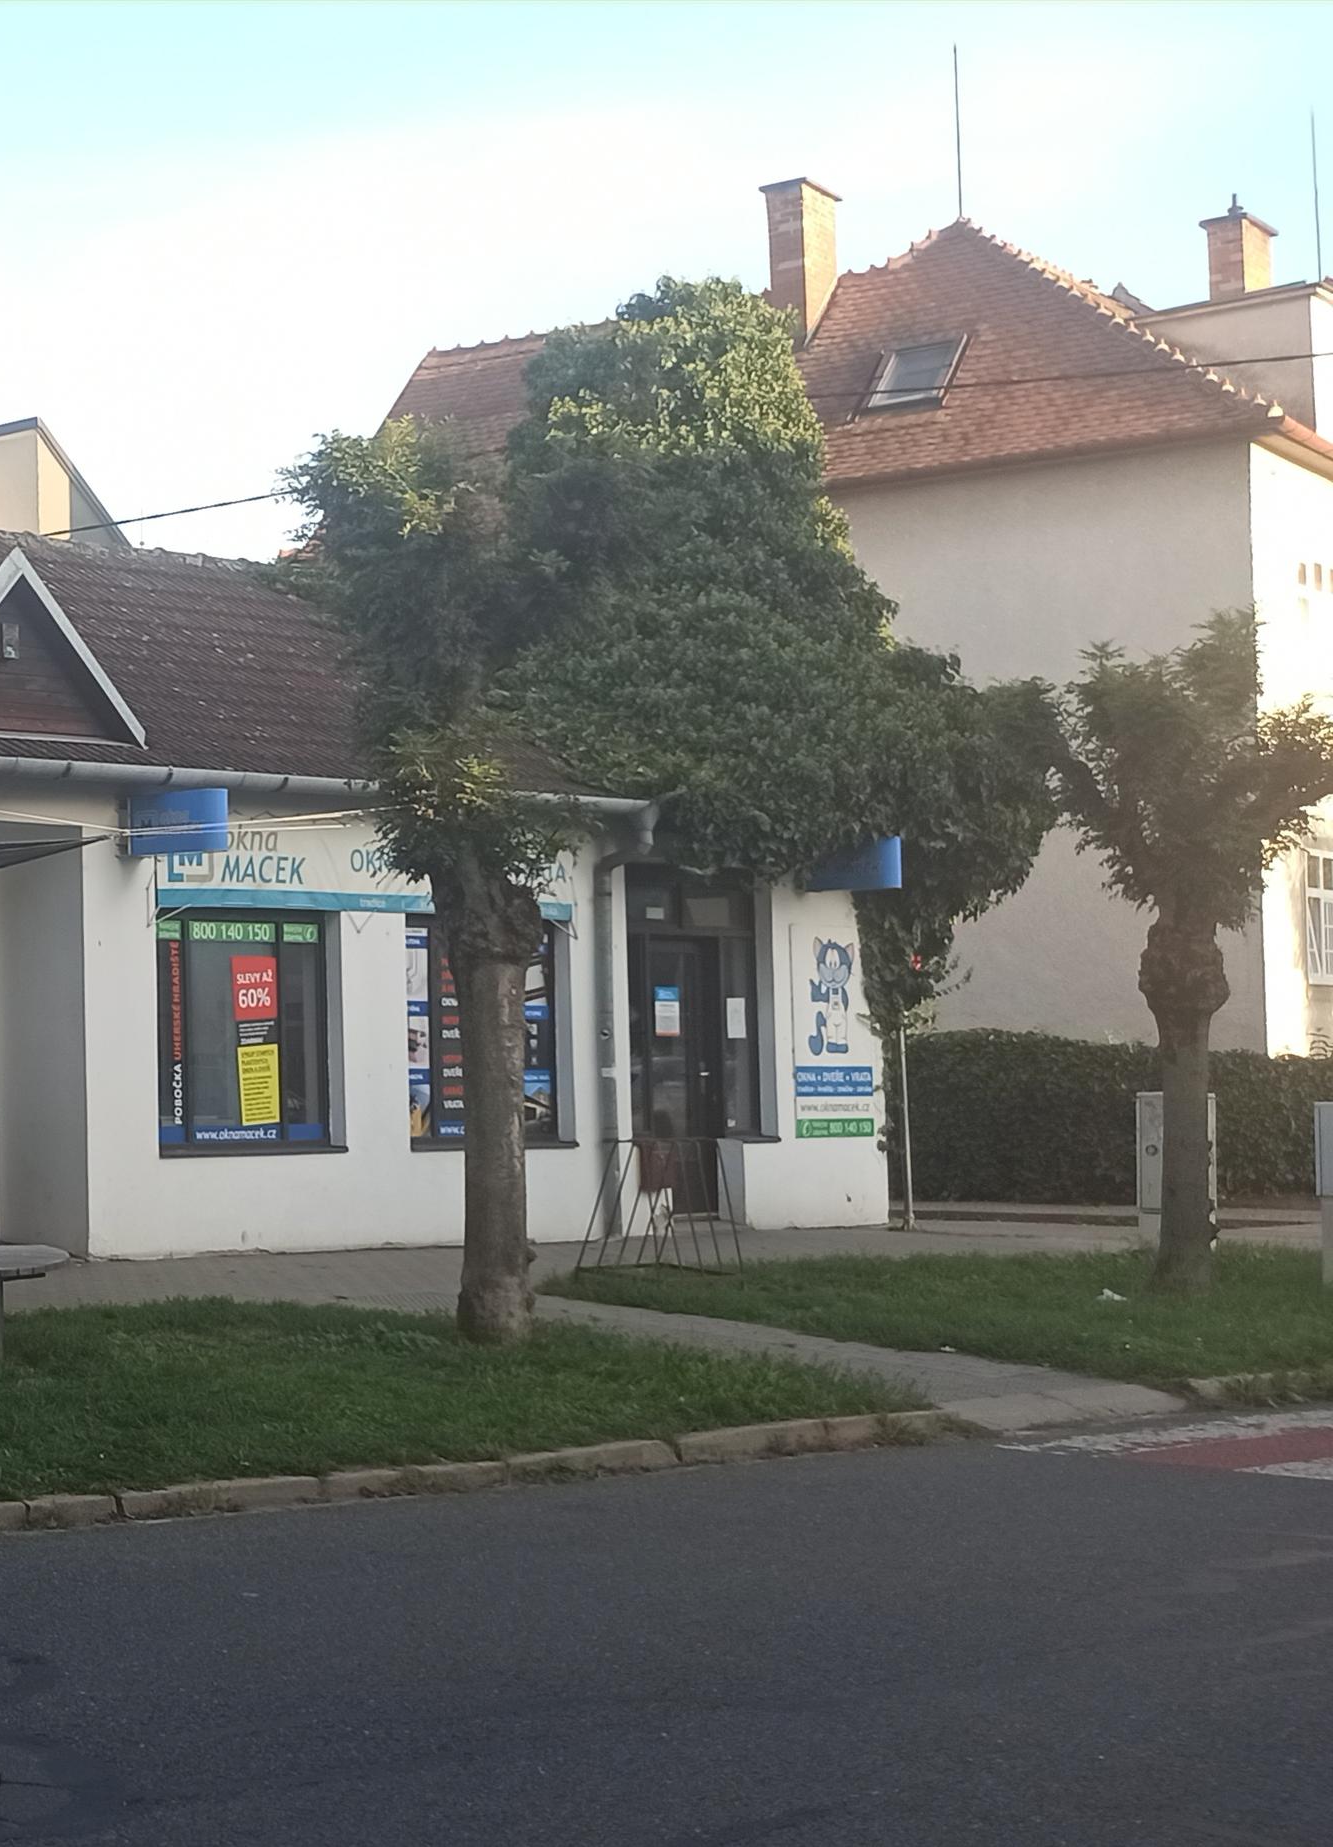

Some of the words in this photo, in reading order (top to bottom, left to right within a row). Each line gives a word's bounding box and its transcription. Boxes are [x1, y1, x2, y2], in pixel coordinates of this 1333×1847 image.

[221, 856, 306, 885] MACEK
[193, 922, 216, 940] 800
[221, 923, 243, 940] 140
[248, 924, 269, 940] 150
[237, 973, 261, 984] SLEVY
[262, 969, 273, 982] AŽ
[239, 988, 271, 1008] 60%
[797, 1071, 817, 1082] OKNA
[172, 1064, 183, 1124] POBOČKA
[196, 1128, 277, 1141] www.oknamacek.cz
[829, 1122, 843, 1134] 800
[845, 1122, 858, 1133] 140
[859, 1121, 873, 1133] 150
